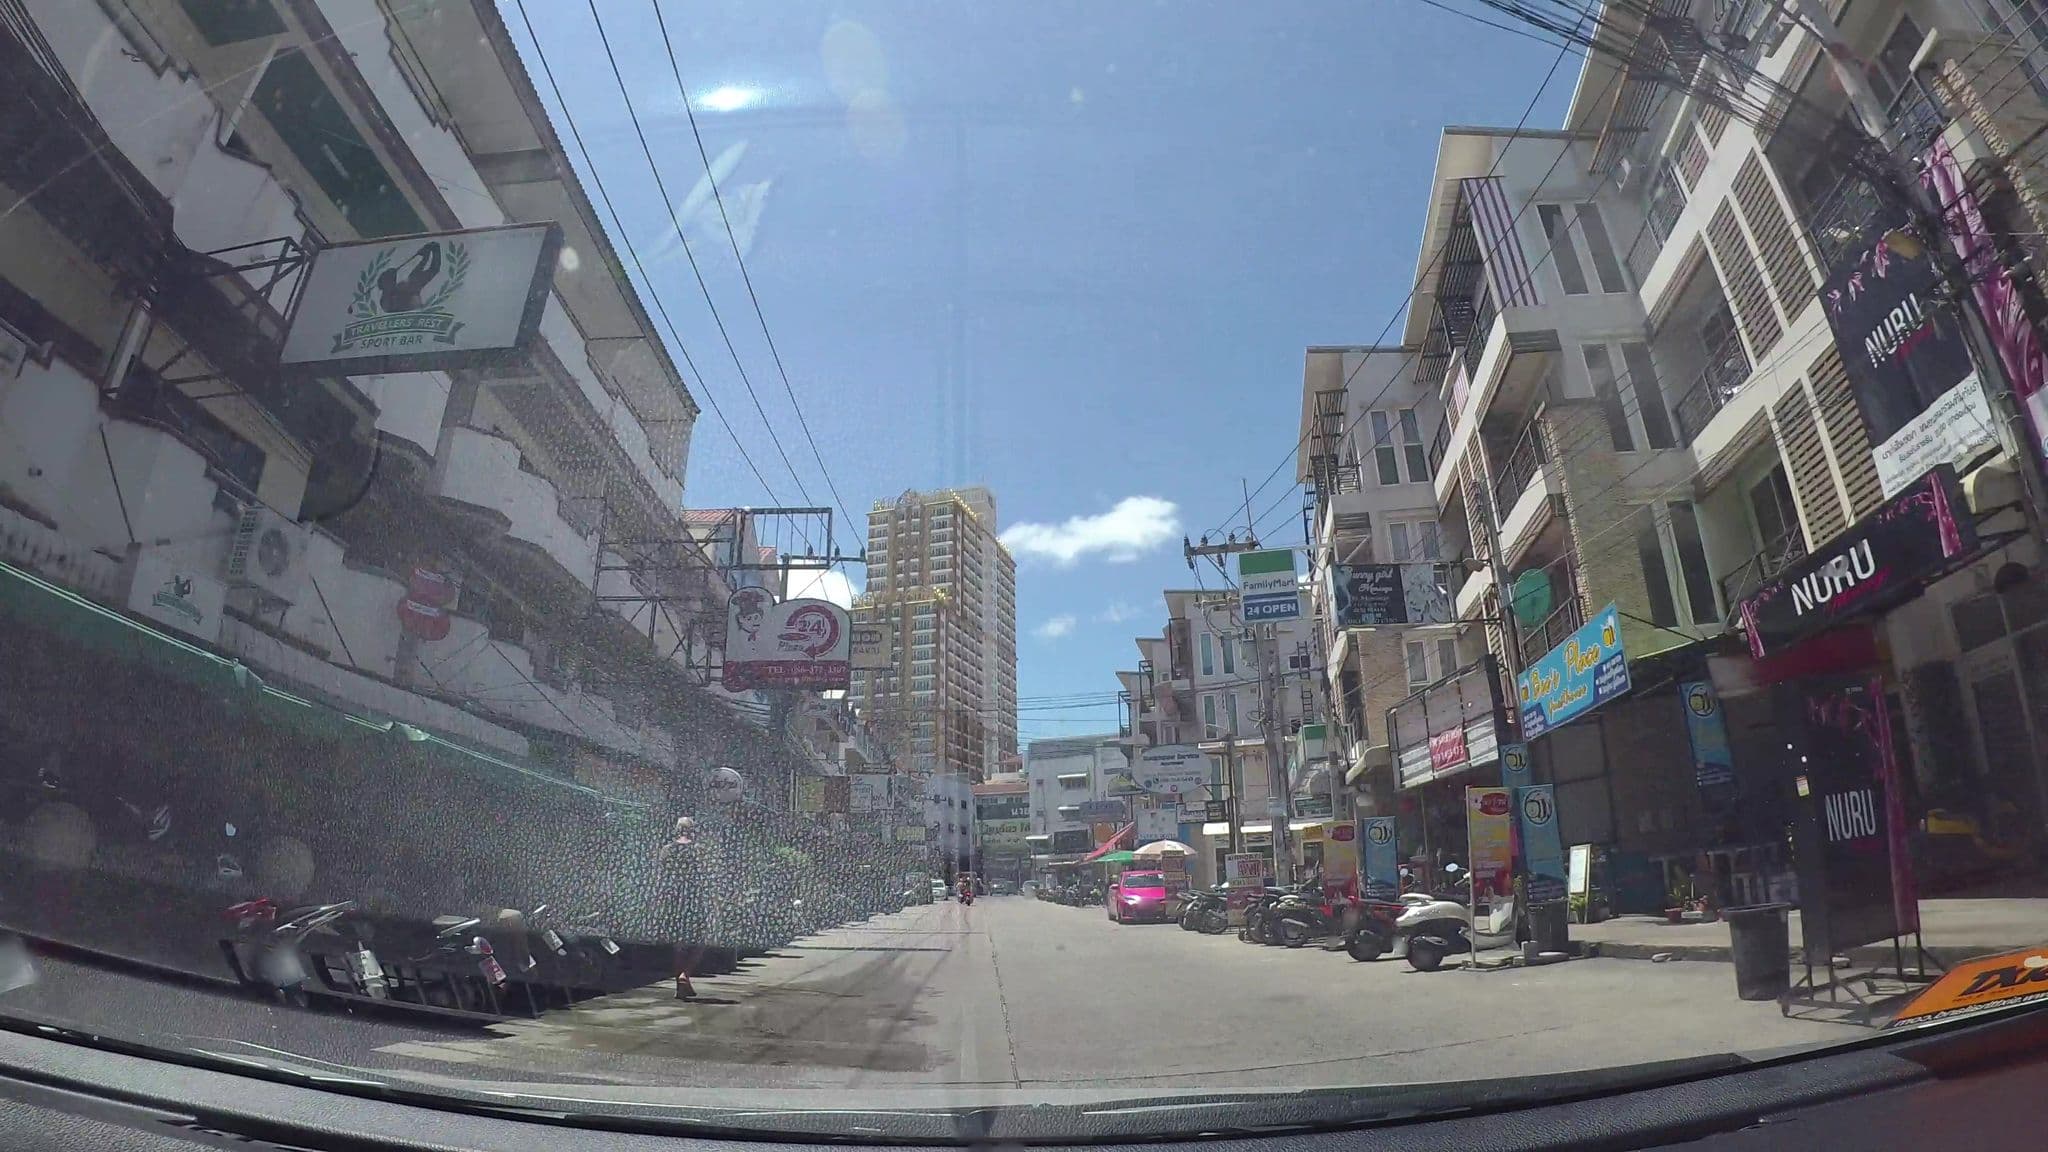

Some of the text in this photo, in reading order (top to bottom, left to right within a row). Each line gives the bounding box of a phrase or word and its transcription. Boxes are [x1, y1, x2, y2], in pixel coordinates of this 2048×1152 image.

[351, 318, 442, 338] TRAVELLERS REST
[1865, 293, 1924, 368] NURU
[360, 335, 423, 349] SPORT BAR
[1243, 579, 1295, 590] FamilyMart
[1791, 539, 1875, 616] NURU
[1247, 603, 1296, 616] 24 OPEN
[798, 617, 826, 637] 24
[1565, 638, 1601, 681] Place
[1825, 788, 1876, 842] NURU
